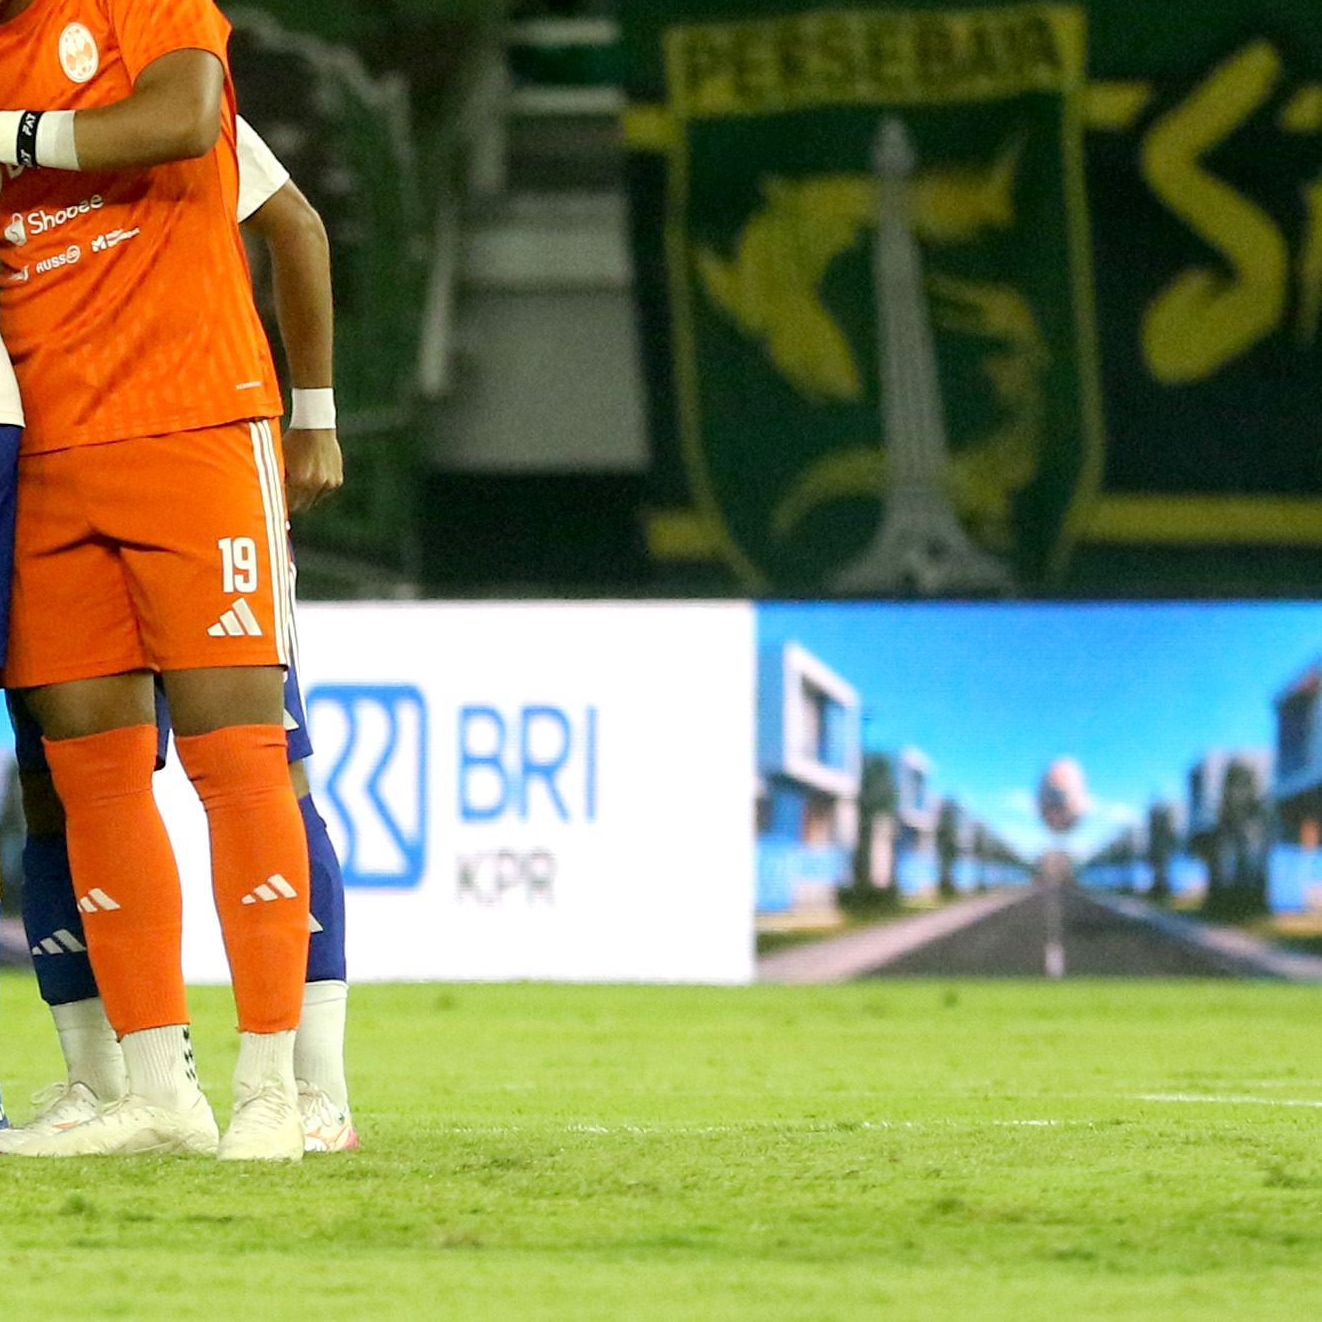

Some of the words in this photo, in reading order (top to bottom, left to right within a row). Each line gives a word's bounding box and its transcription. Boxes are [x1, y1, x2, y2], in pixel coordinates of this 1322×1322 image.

[218, 537, 258, 593] 19
[457, 702, 597, 824] BRI
[456, 851, 556, 906] KPR
